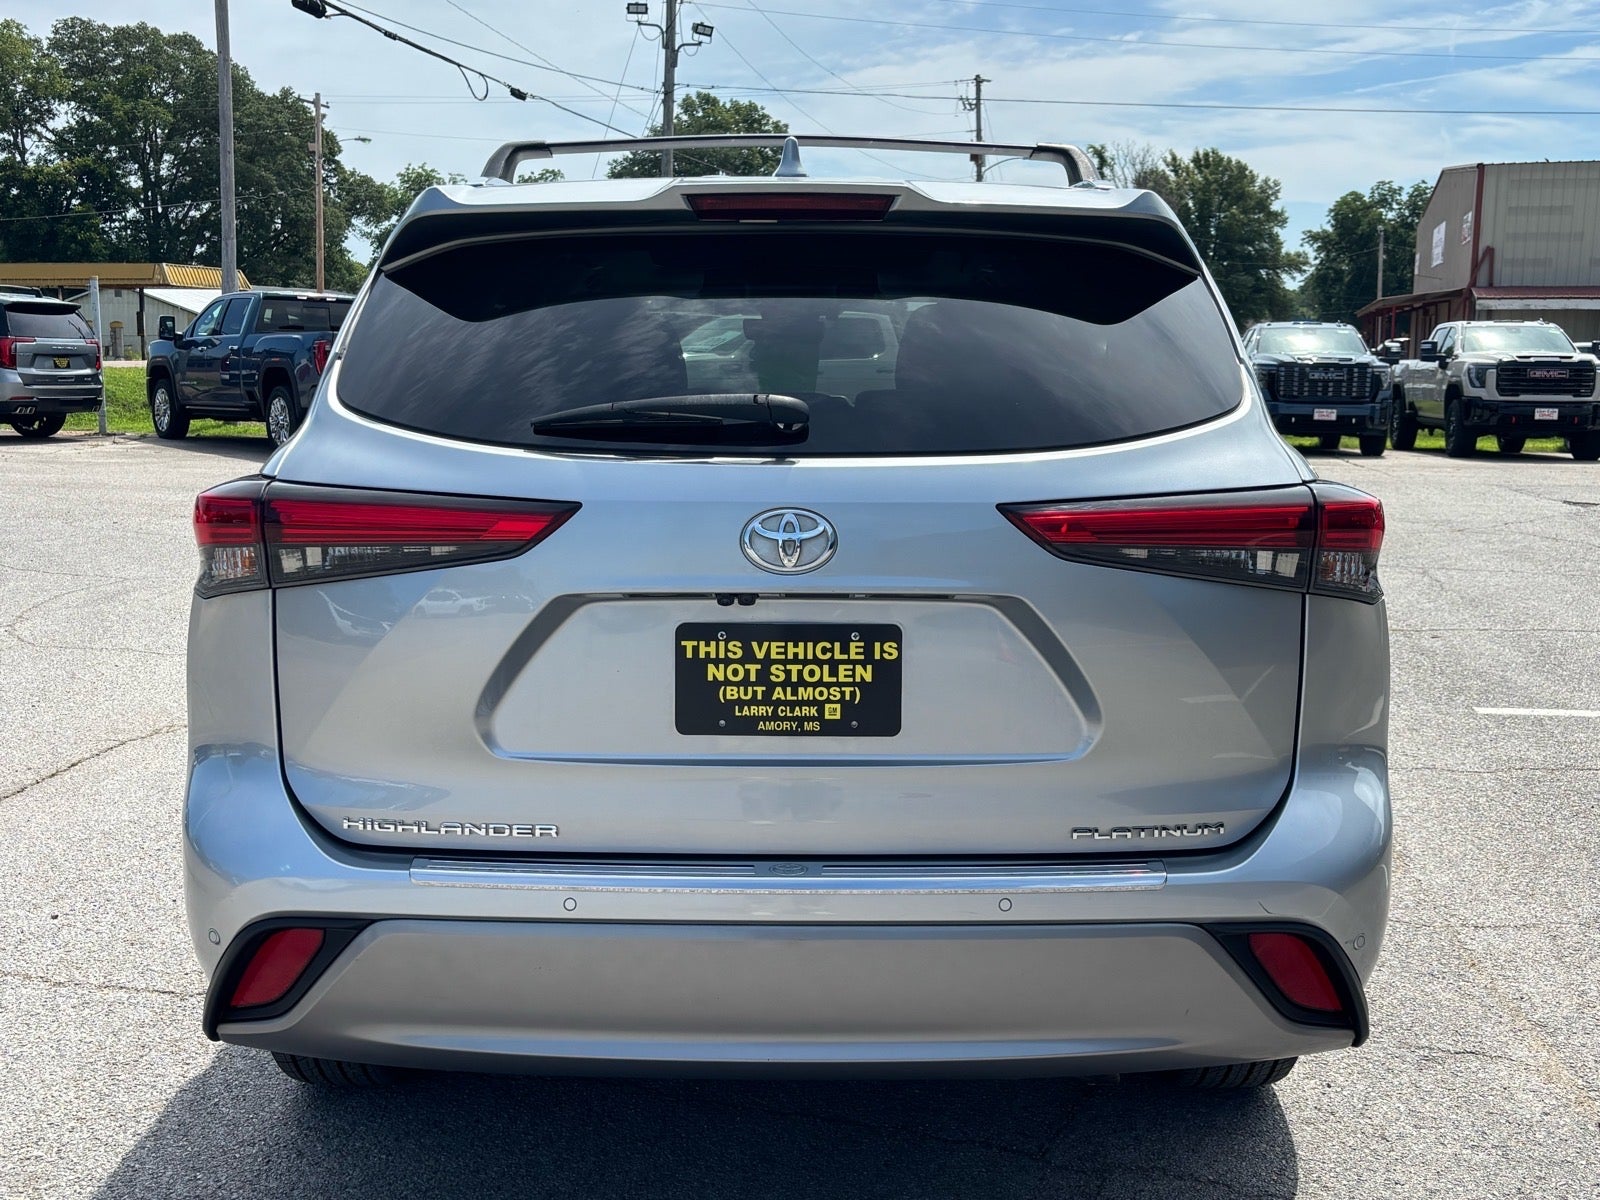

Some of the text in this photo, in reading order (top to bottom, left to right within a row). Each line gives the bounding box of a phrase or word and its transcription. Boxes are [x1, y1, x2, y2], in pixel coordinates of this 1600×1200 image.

[1529, 370, 1567, 378] GMC
[681, 640, 899, 660] THIS VEHICLE IS
[707, 663, 873, 683] NOT STOLEN
[718, 686, 861, 704] (BUT ALMOST)
[735, 705, 773, 717] LARRY
[777, 706, 818, 717] CLARK
[757, 721, 821, 732] AMORY, MS
[342, 816, 559, 838] HIGHLANDER
[1071, 821, 1225, 840] PLATINUM
